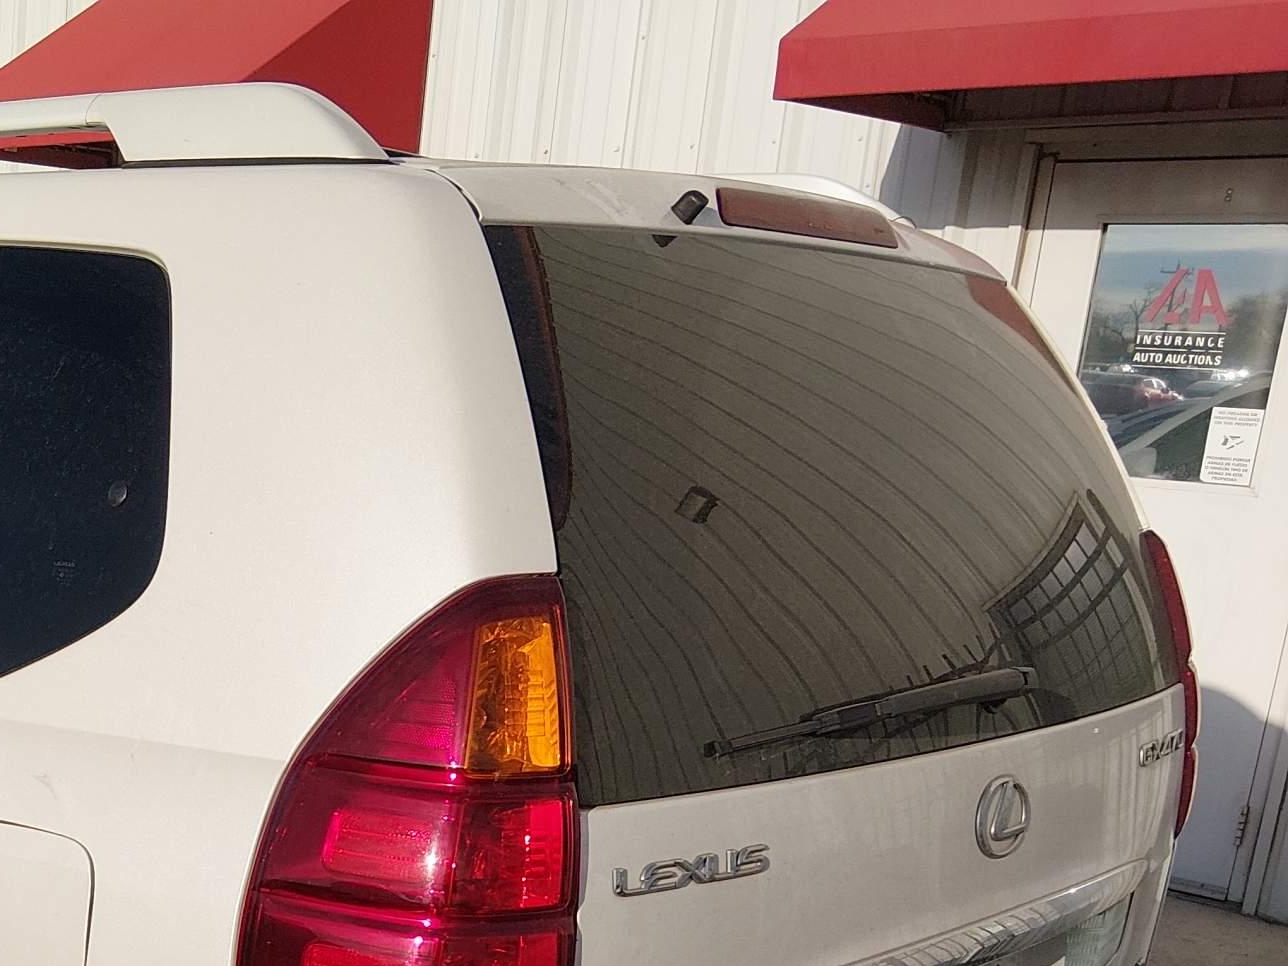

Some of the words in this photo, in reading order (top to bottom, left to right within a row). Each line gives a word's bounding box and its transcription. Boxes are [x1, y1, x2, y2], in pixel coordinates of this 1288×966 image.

[1136, 334, 1225, 348] INSURANCE
[1133, 352, 1163, 363] AUTO
[1164, 354, 1222, 366] AUCTIONS
[612, 843, 770, 897] LEXUS
